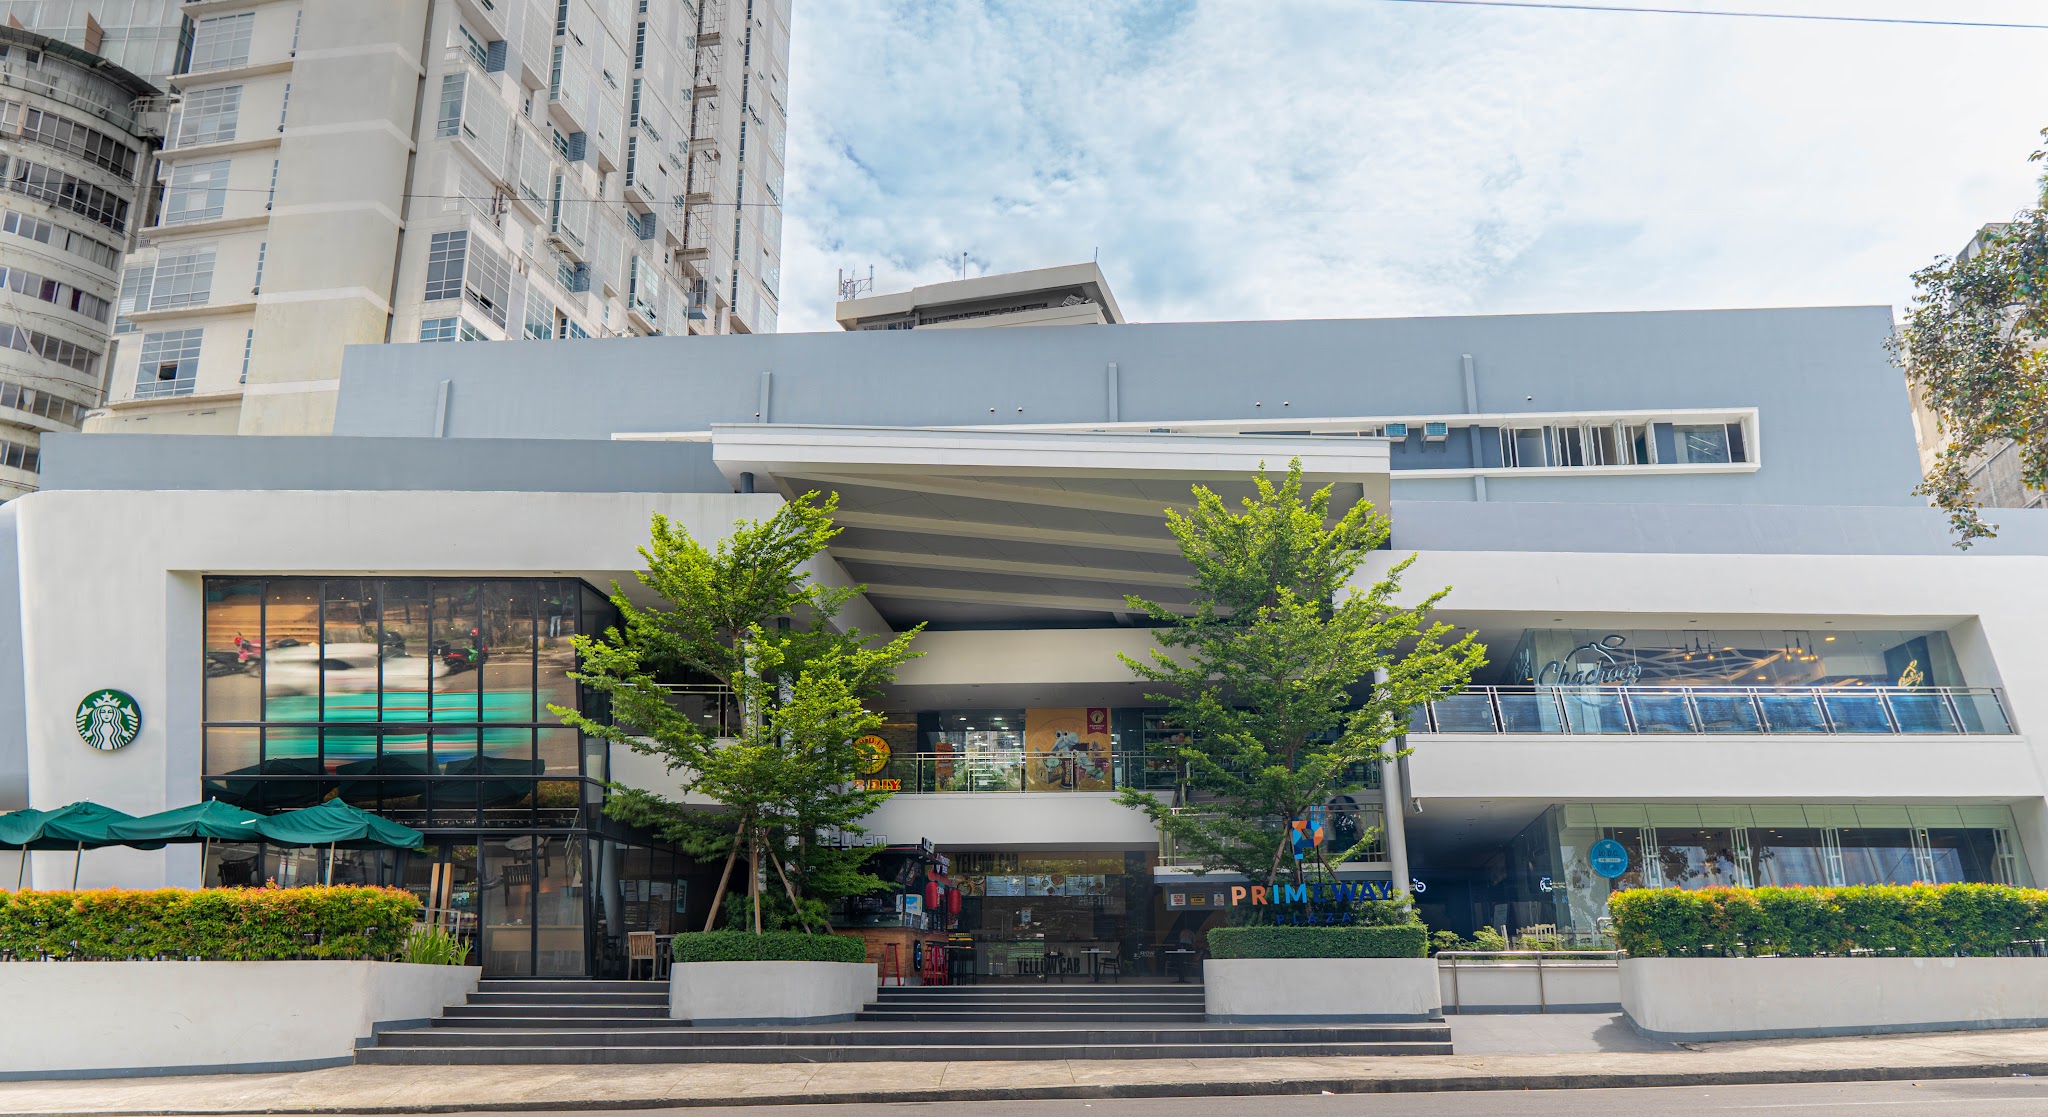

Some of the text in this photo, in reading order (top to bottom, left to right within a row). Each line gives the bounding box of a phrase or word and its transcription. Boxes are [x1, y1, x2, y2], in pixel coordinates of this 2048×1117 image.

[955, 852, 995, 873] YELLOW
[999, 853, 1018, 873] CAB
[1079, 896, 1114, 905] 254-1111
[1231, 881, 1393, 906] PRIMEWAY
[1277, 912, 1351, 925] PLAZA
[1017, 957, 1081, 974] YELLOW CAB
